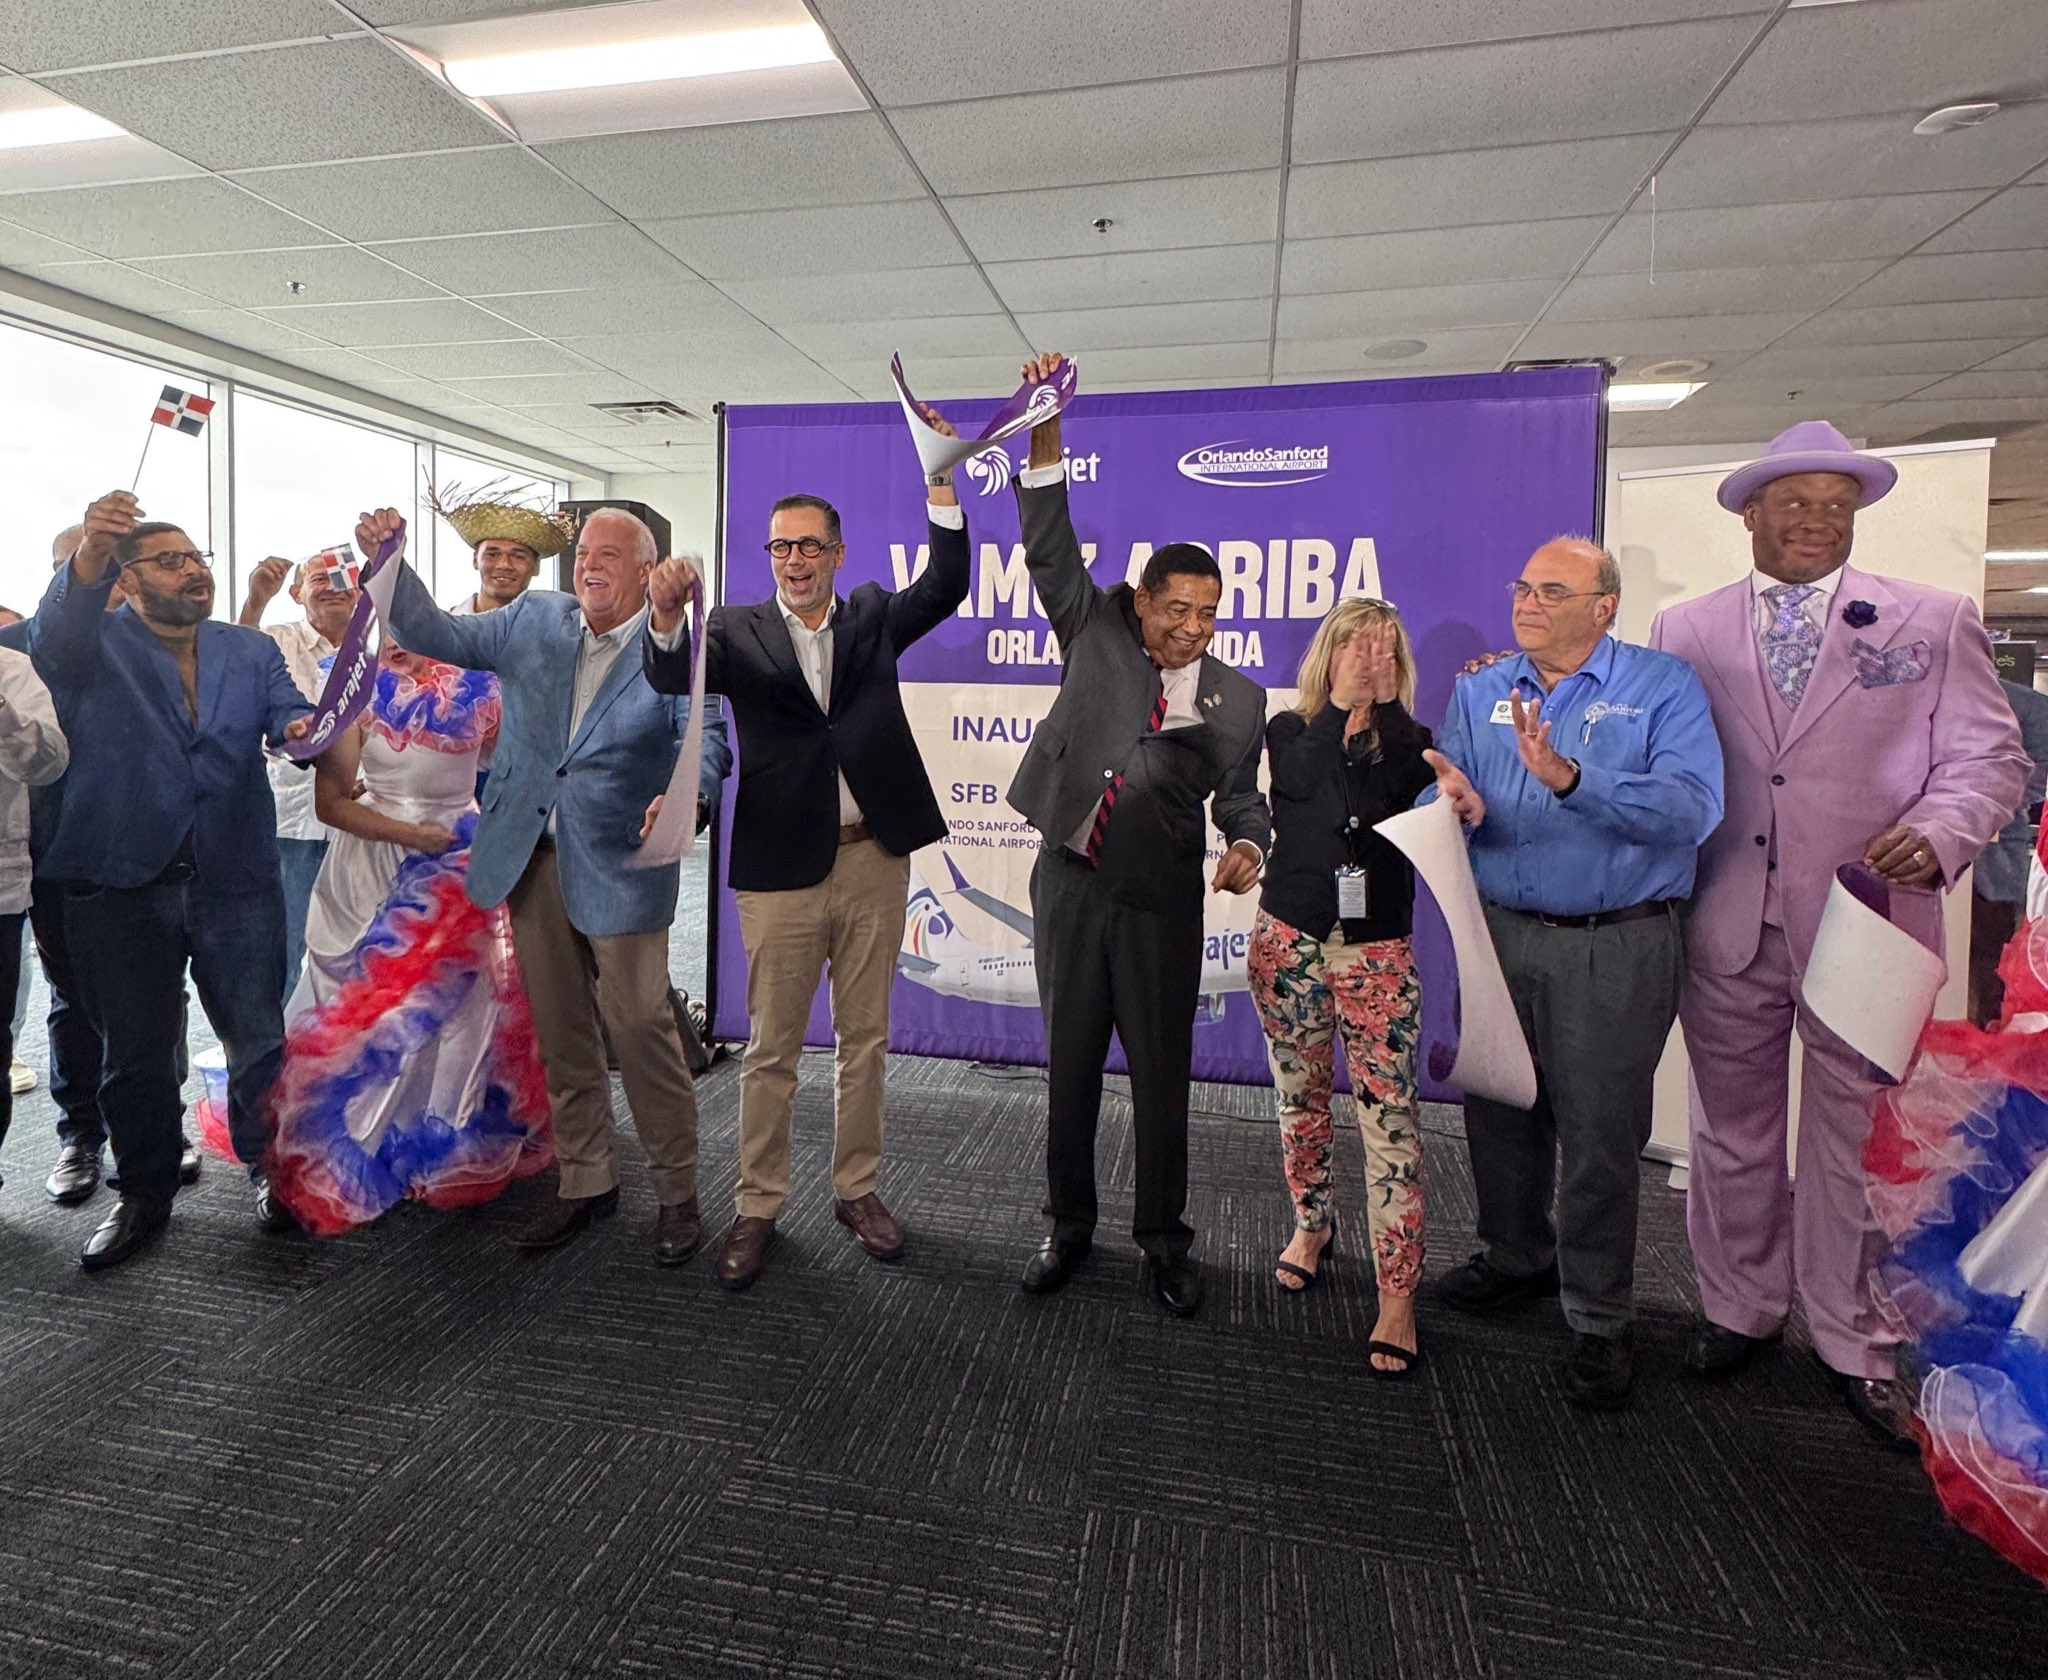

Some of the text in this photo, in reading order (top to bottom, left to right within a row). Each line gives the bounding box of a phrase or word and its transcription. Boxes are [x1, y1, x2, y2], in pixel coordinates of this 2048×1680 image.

[1200, 460, 1324, 473] INTERNATIONAL AIRPORT
[987, 629, 1065, 665] ORLA
[336, 651, 367, 716] arajet
[951, 782, 998, 804] SFB
